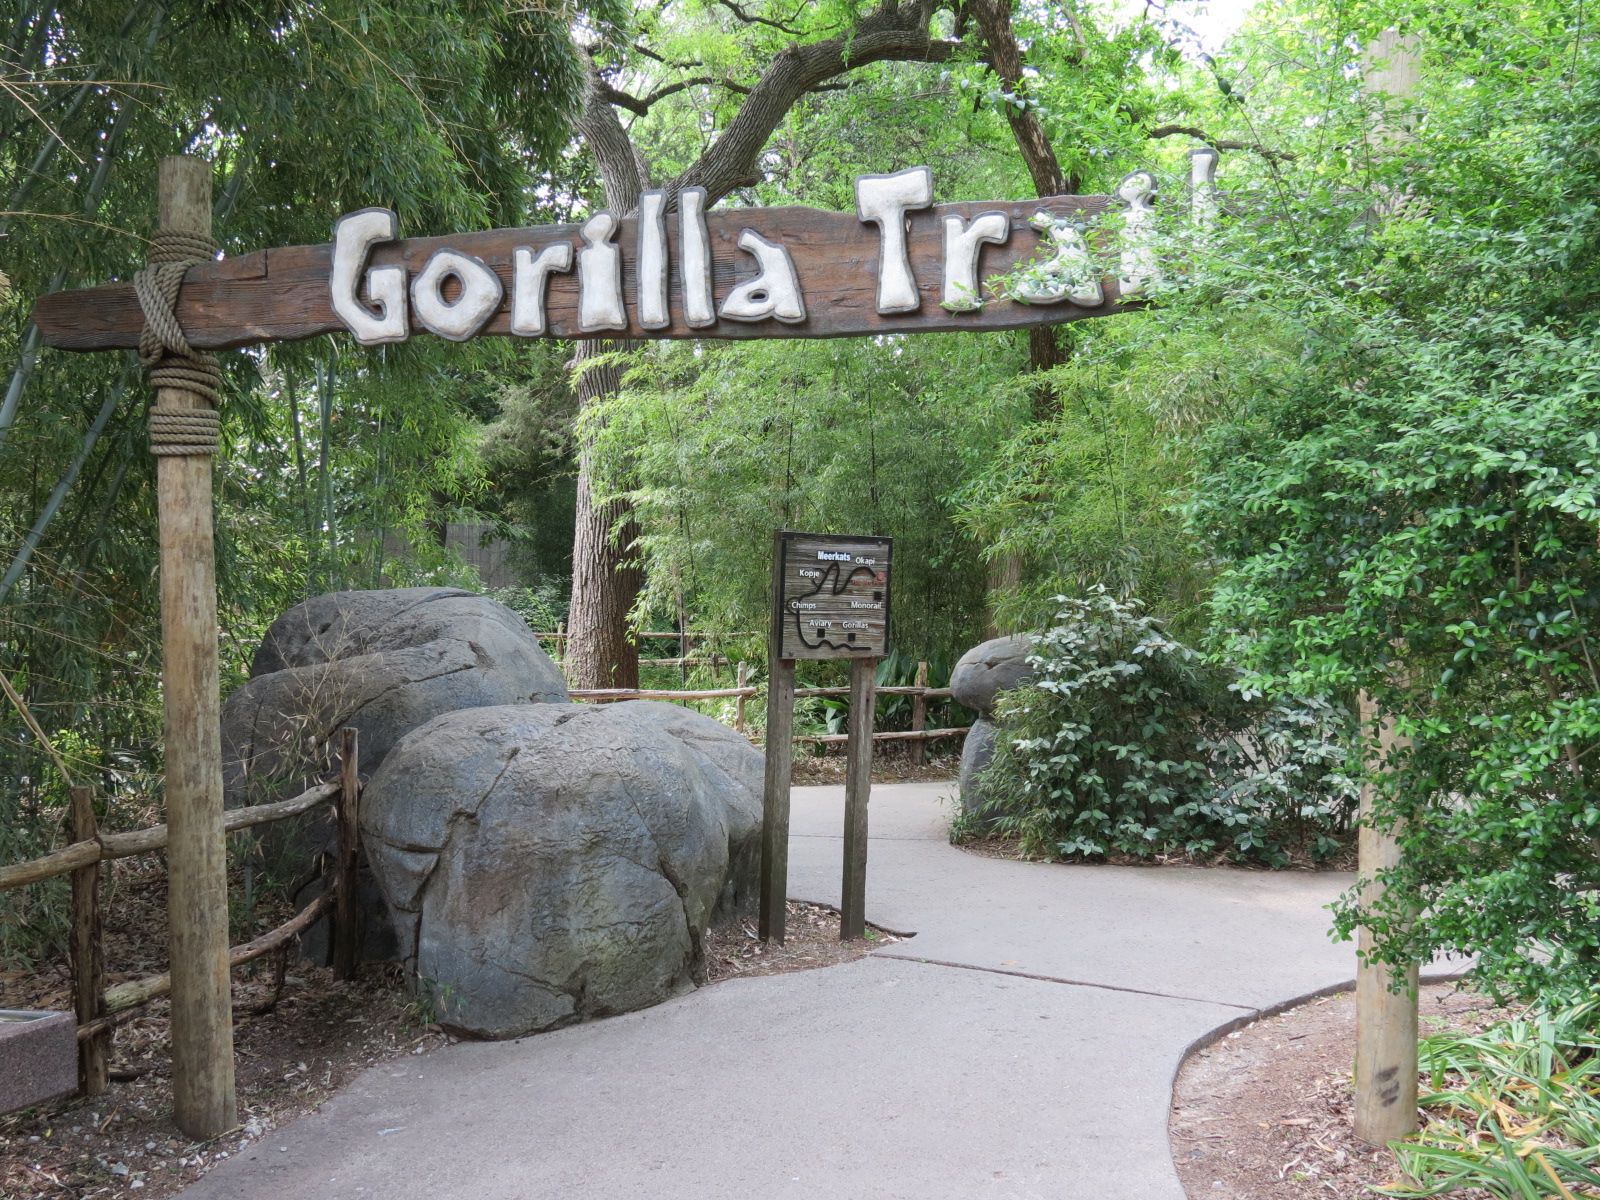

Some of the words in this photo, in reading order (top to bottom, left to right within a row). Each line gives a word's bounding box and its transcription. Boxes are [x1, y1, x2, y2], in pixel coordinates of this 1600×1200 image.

[329, 186, 806, 346] Gorilla
[817, 551, 851, 561] Meerkats
[855, 556, 876, 566] Okapi
[799, 569, 820, 579] Kopje
[791, 601, 817, 610] Chimps
[850, 601, 882, 610] Monorail
[809, 620, 832, 629] Aviary
[842, 621, 869, 629] Gorillas
